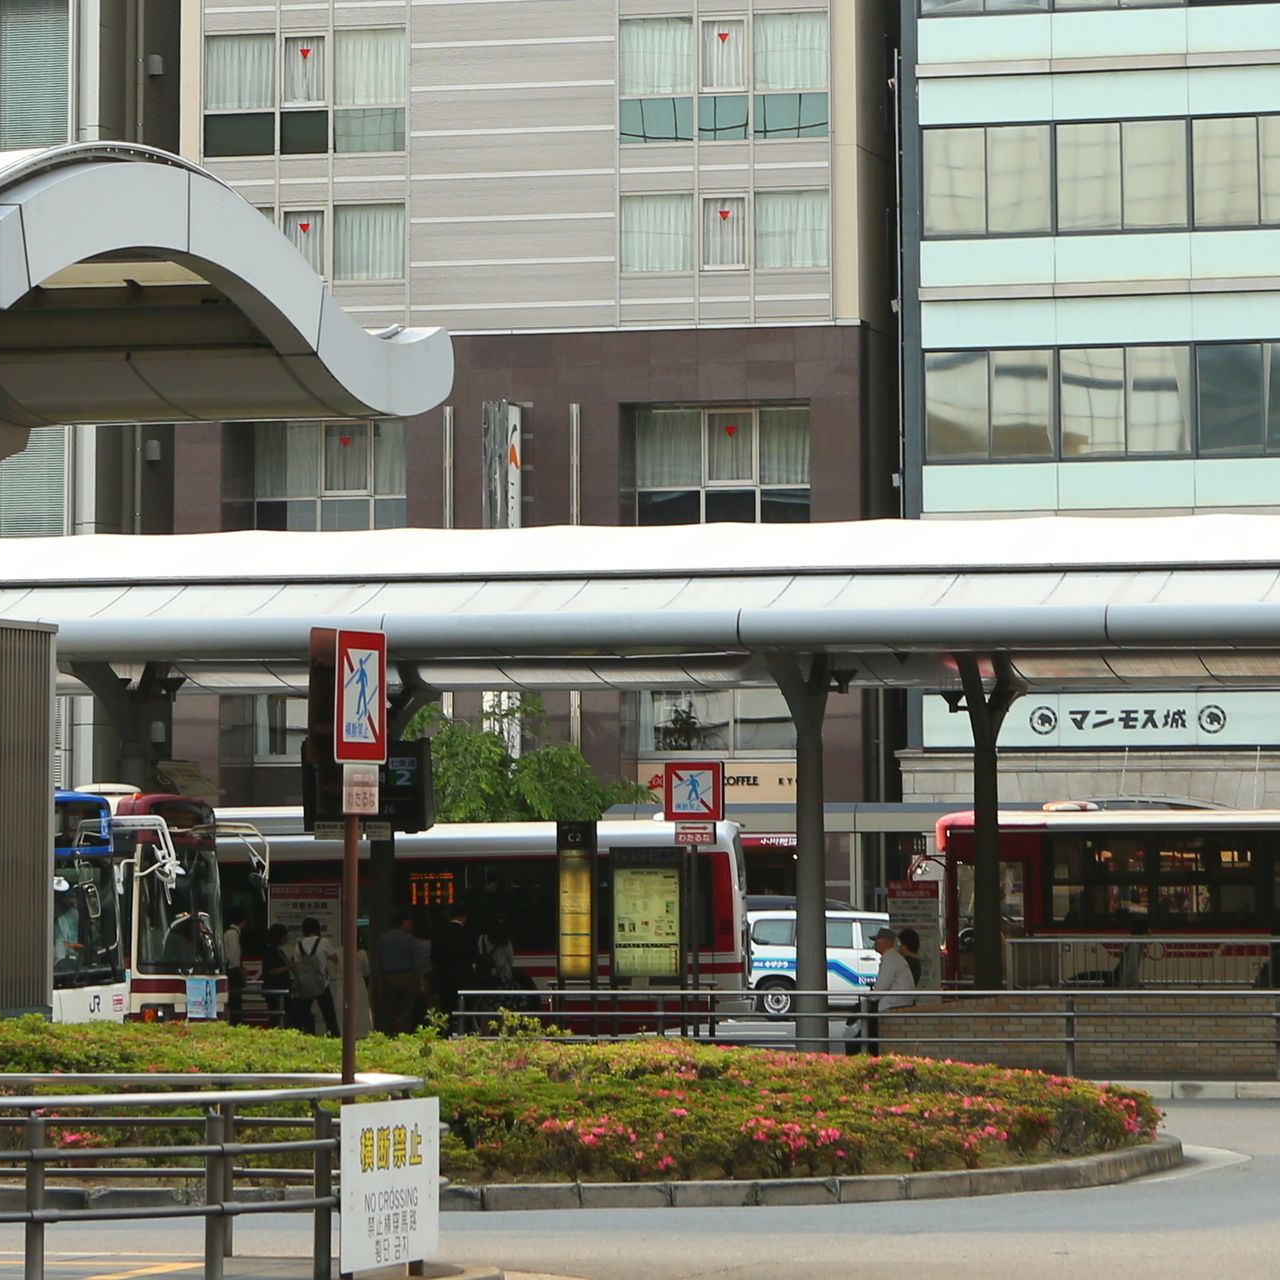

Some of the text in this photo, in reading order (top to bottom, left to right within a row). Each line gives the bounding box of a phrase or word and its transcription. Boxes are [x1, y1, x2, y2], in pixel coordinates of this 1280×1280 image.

[1068, 709, 1187, 731] マンモス城
[396, 770, 412, 785] 2
[724, 776, 797, 786] COFFEE KY
[568, 833, 582, 842] C2
[678, 834, 710, 842] わたるな
[89, 994, 101, 1013] JR
[360, 1122, 423, 1173] 横断禁止
[364, 1186, 418, 1213] NO CROSSING
